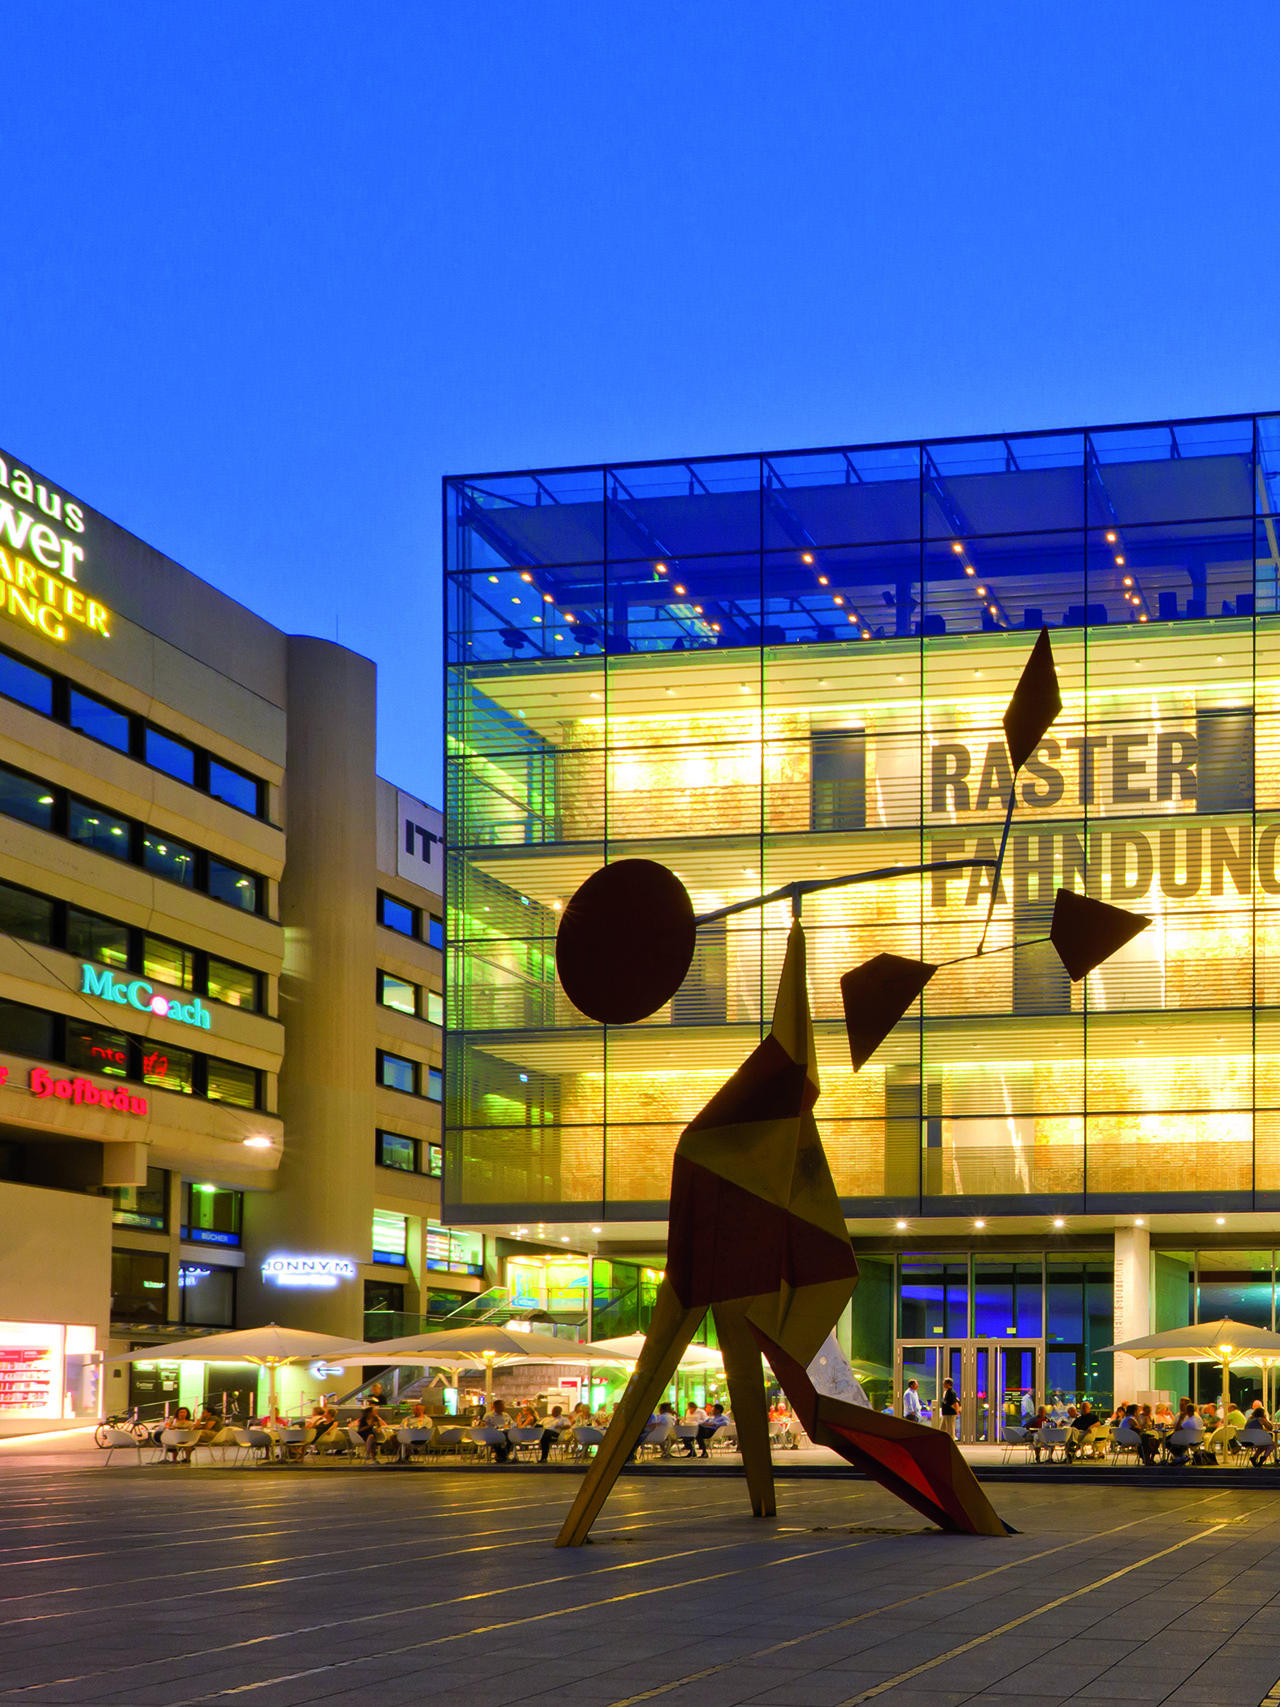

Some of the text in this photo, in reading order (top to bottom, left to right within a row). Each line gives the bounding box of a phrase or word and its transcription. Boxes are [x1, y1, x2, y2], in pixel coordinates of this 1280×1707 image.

[0, 577, 67, 641] NG
[931, 731, 1198, 813] RASTER
[405, 818, 444, 865] IT
[82, 963, 211, 1030] McCoach
[30, 1067, 147, 1116] Hofbräu
[201, 1231, 229, 1243] BÜCHER
[262, 1260, 330, 1272] JONNY
